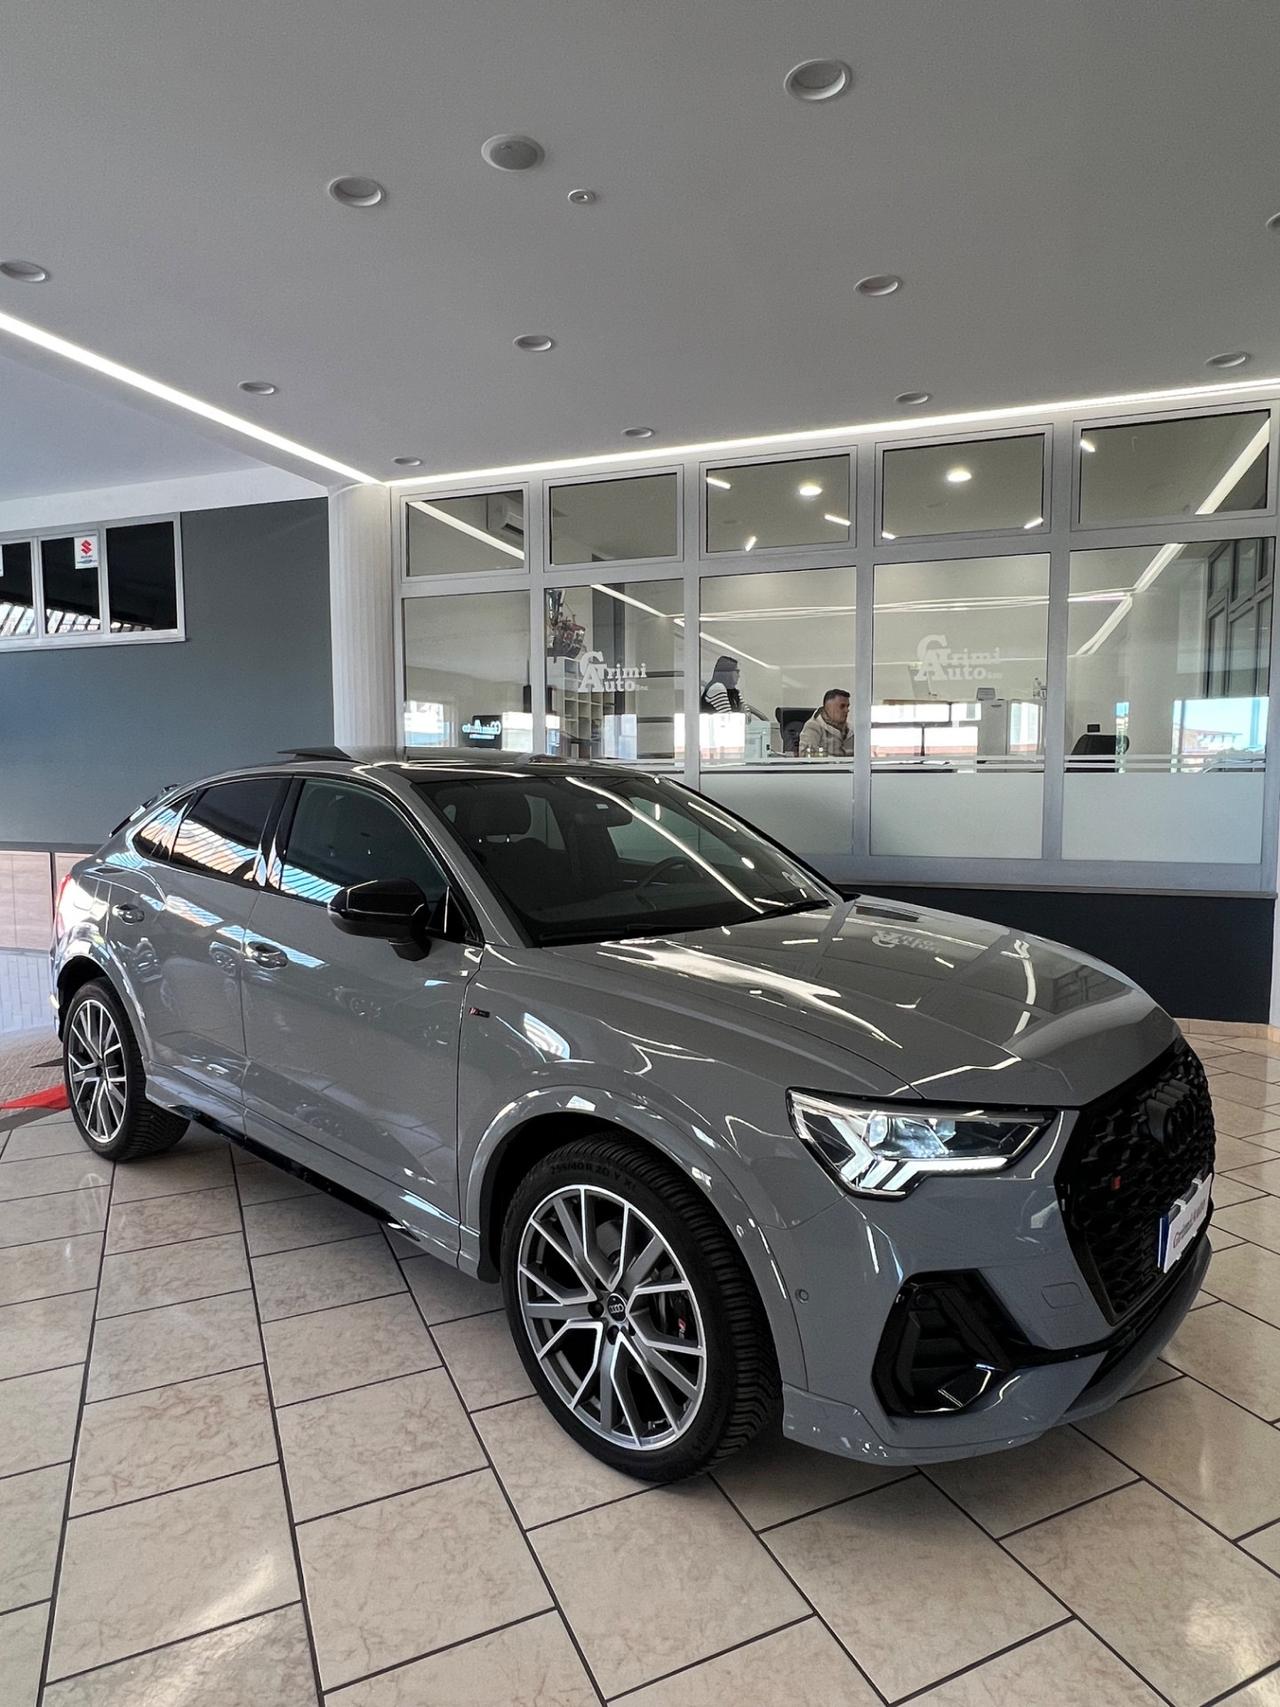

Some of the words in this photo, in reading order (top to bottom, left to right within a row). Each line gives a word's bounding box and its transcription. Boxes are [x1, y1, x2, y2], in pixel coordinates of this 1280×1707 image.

[917, 634, 1001, 665] Crimi
[578, 664, 636, 692] Auto
[580, 651, 648, 679] Crimi
[914, 649, 986, 681] Auto
